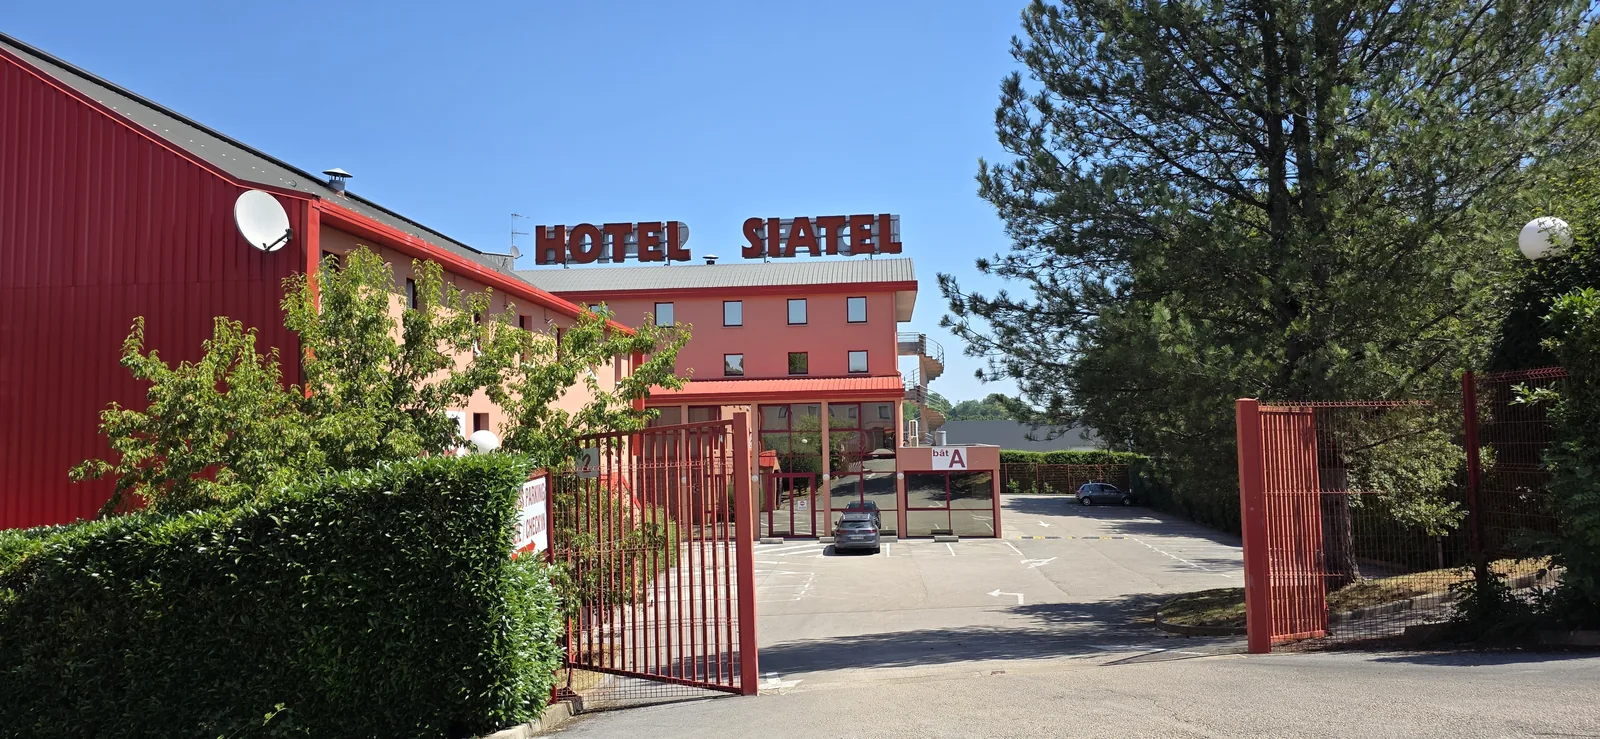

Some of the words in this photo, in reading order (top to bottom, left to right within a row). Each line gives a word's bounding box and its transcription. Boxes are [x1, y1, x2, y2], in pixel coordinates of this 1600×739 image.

[535, 220, 691, 265] HOTEL
[742, 213, 902, 259] SIATEL
[581, 453, 592, 473] 2
[933, 449, 949, 457] bât
[949, 449, 966, 468] A
[525, 482, 546, 508] PARKING
